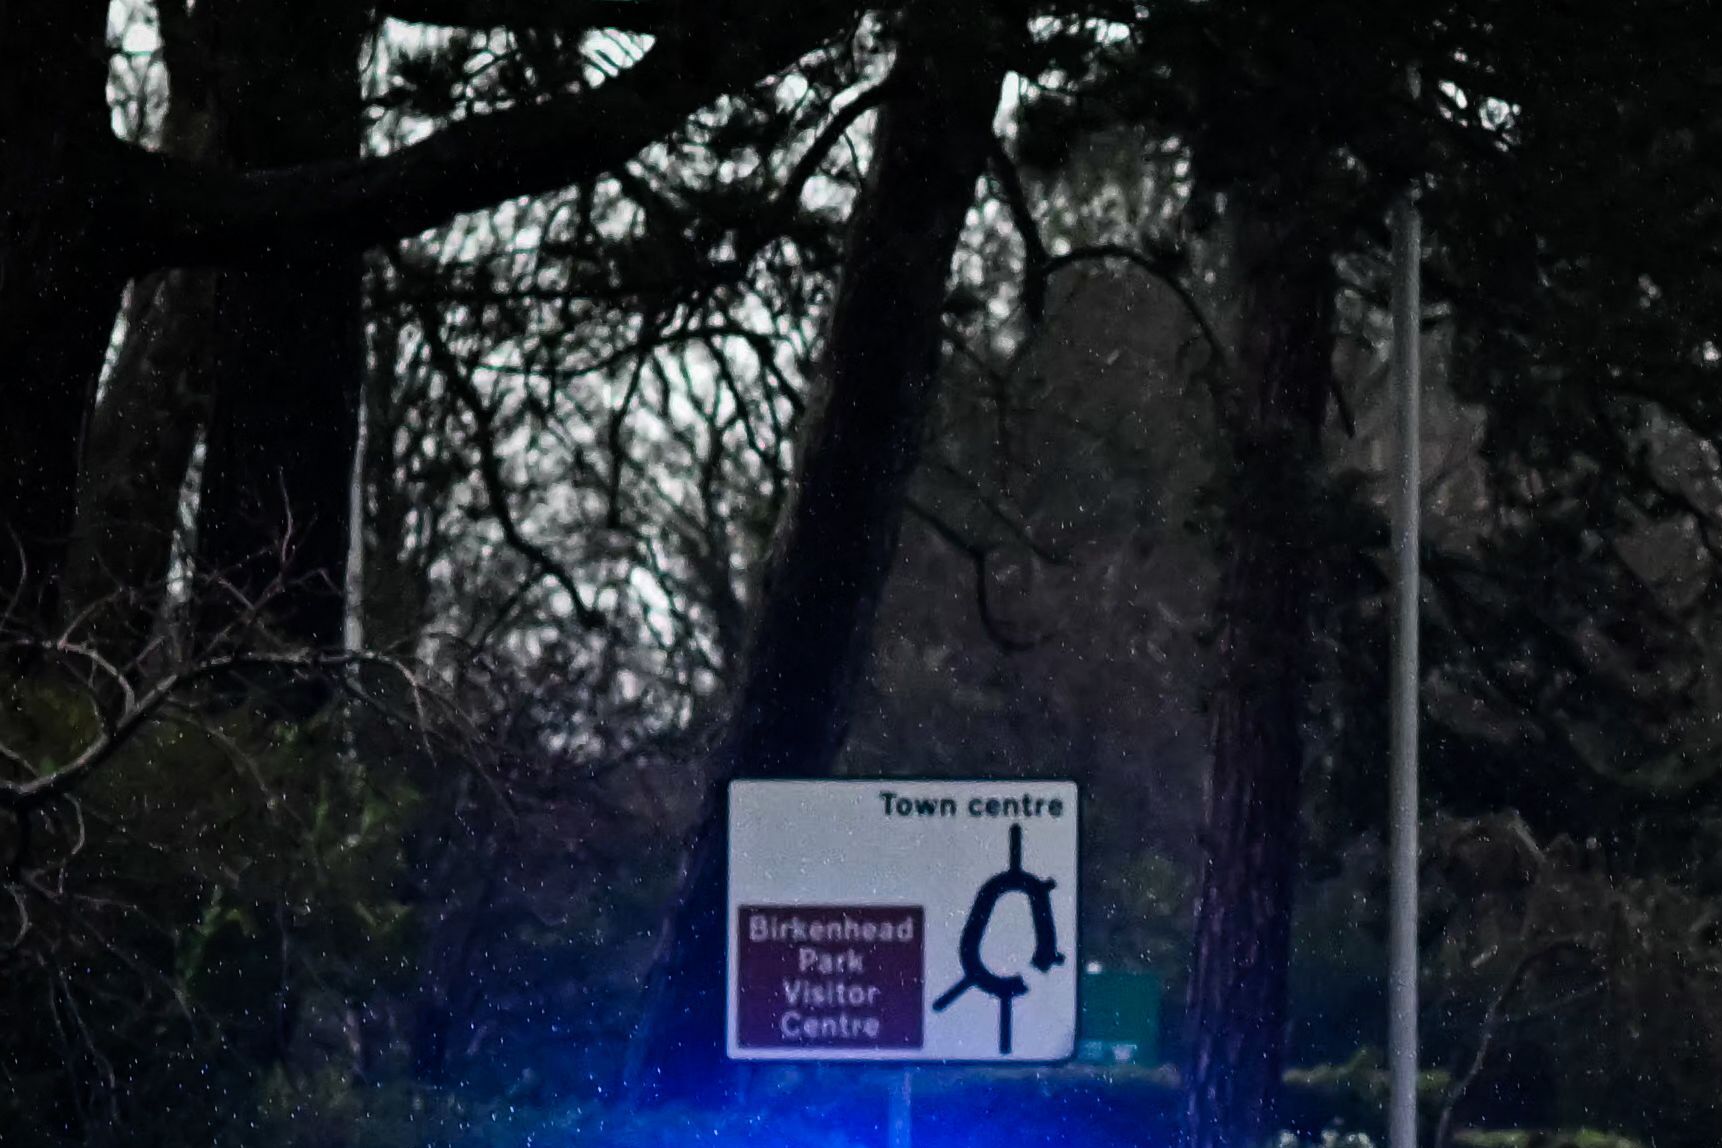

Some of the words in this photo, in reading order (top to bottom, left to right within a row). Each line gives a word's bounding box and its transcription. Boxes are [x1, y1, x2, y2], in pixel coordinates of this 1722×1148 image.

[880, 792, 957, 818] Town
[968, 793, 1064, 818] centre
[749, 916, 914, 942] Birkenhead
[798, 947, 865, 973] Park
[782, 980, 880, 1007] Visitor
[780, 1011, 881, 1040] Centre
